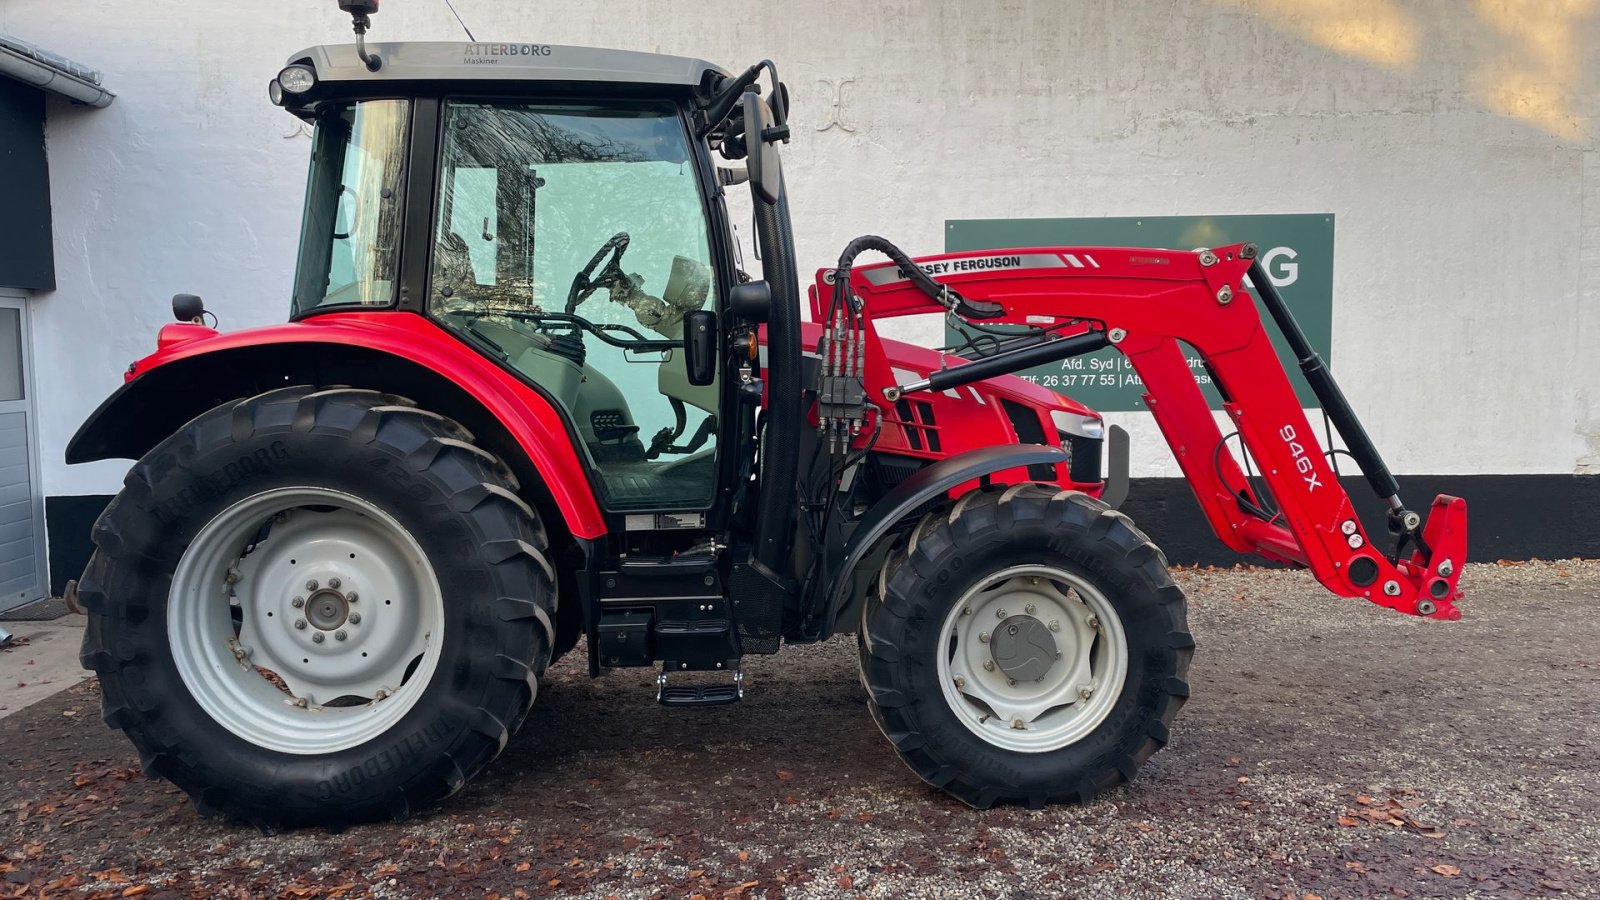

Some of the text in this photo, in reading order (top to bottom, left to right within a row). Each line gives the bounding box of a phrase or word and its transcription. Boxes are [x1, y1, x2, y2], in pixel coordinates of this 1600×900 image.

[464, 43, 552, 56] ATTERBORG
[463, 57, 498, 65] Maskiner
[953, 256, 1021, 272] FERGUSON
[1061, 358, 1086, 370] Afd.
[1089, 358, 1114, 372] Syd
[1042, 375, 1059, 387] 26
[1062, 375, 1077, 386] 37
[1081, 375, 1096, 386] 77
[1100, 374, 1115, 385] 55
[1279, 424, 1323, 494] 946X
[316, 709, 458, 801] TRELLEBORG
